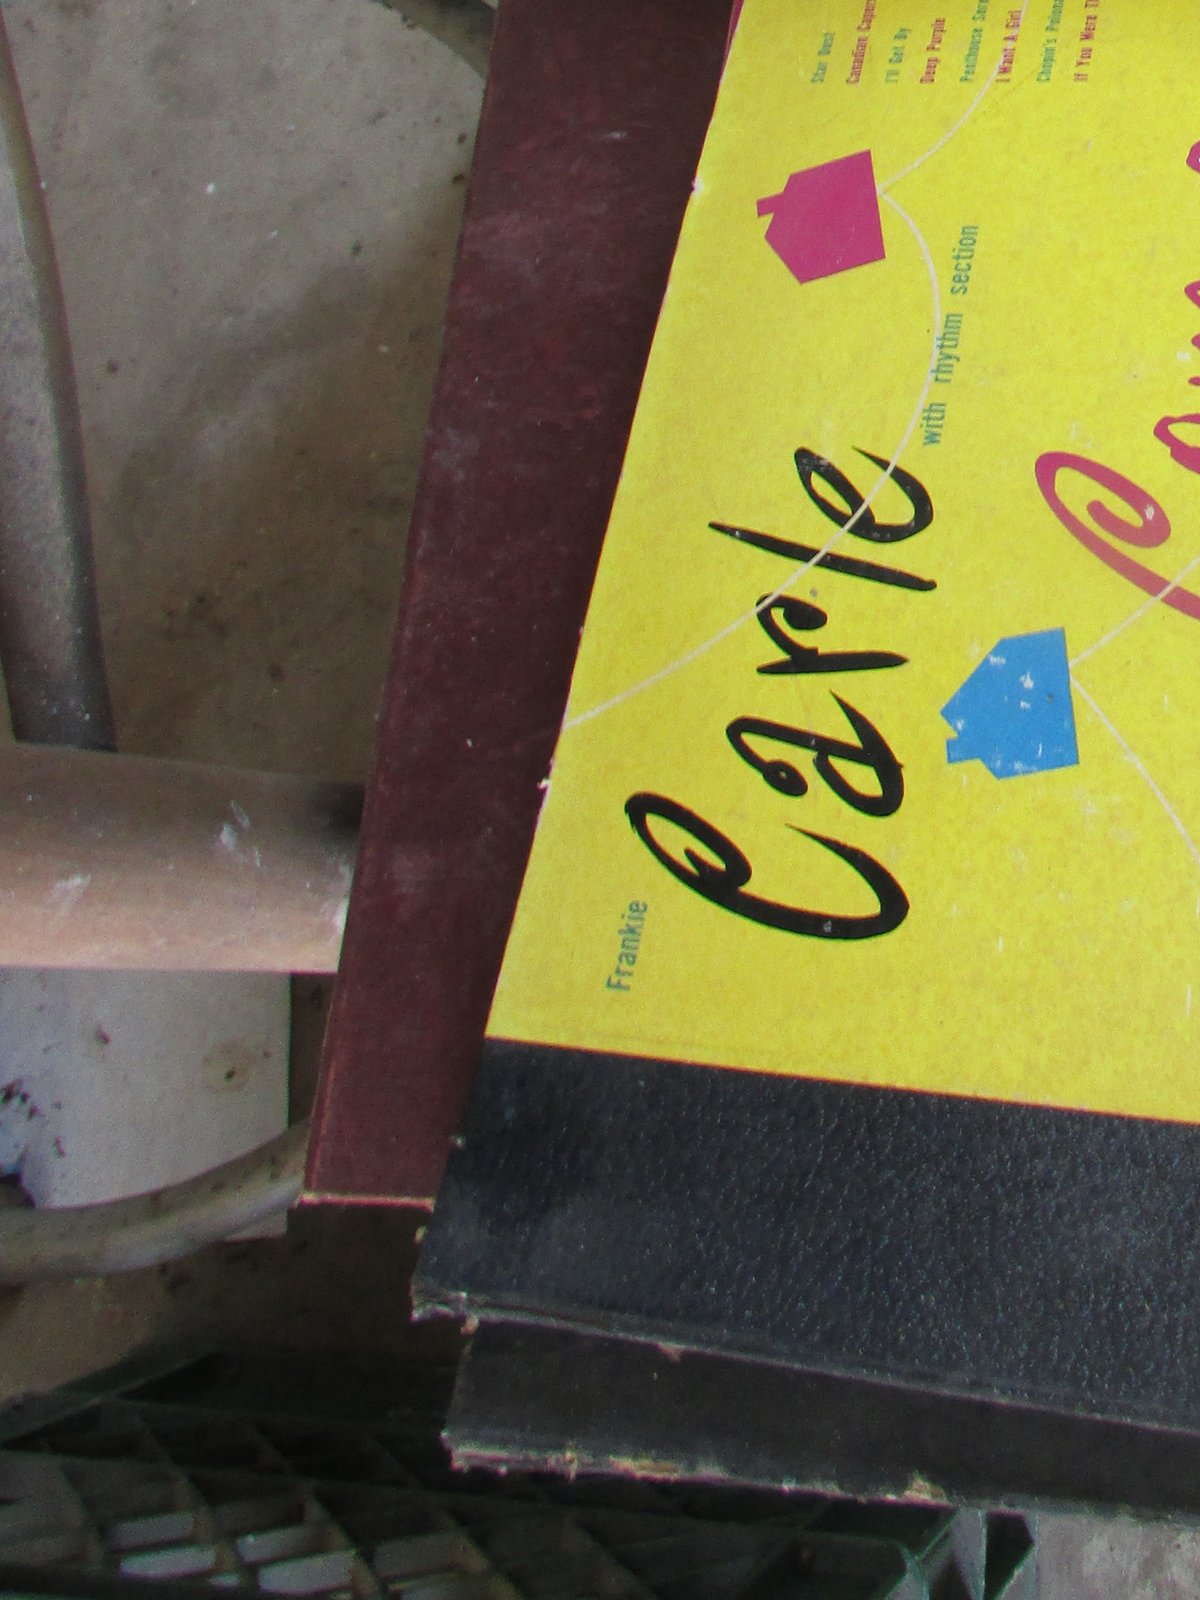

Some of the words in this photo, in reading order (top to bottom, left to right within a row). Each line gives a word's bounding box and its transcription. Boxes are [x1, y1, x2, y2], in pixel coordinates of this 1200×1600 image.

[893, 26, 911, 40] By
[927, 16, 947, 50] Purple
[1005, 8, 1023, 28] Girl
[1079, 13, 1098, 40] Were
[1003, 33, 1019, 42] A
[845, 35, 870, 84] Canadian
[888, 45, 905, 63] Get
[959, 27, 983, 82] Penthouse
[997, 47, 1016, 73] Want
[1036, 36, 1058, 82] Chopin's
[1075, 46, 1094, 67] You
[919, 56, 942, 83] Deep
[1072, 72, 1089, 82] If
[945, 223, 980, 295] section
[928, 311, 965, 384] rhythm
[917, 401, 948, 446] with
[624, 443, 938, 941] Carle
[605, 899, 648, 991] Frankie
